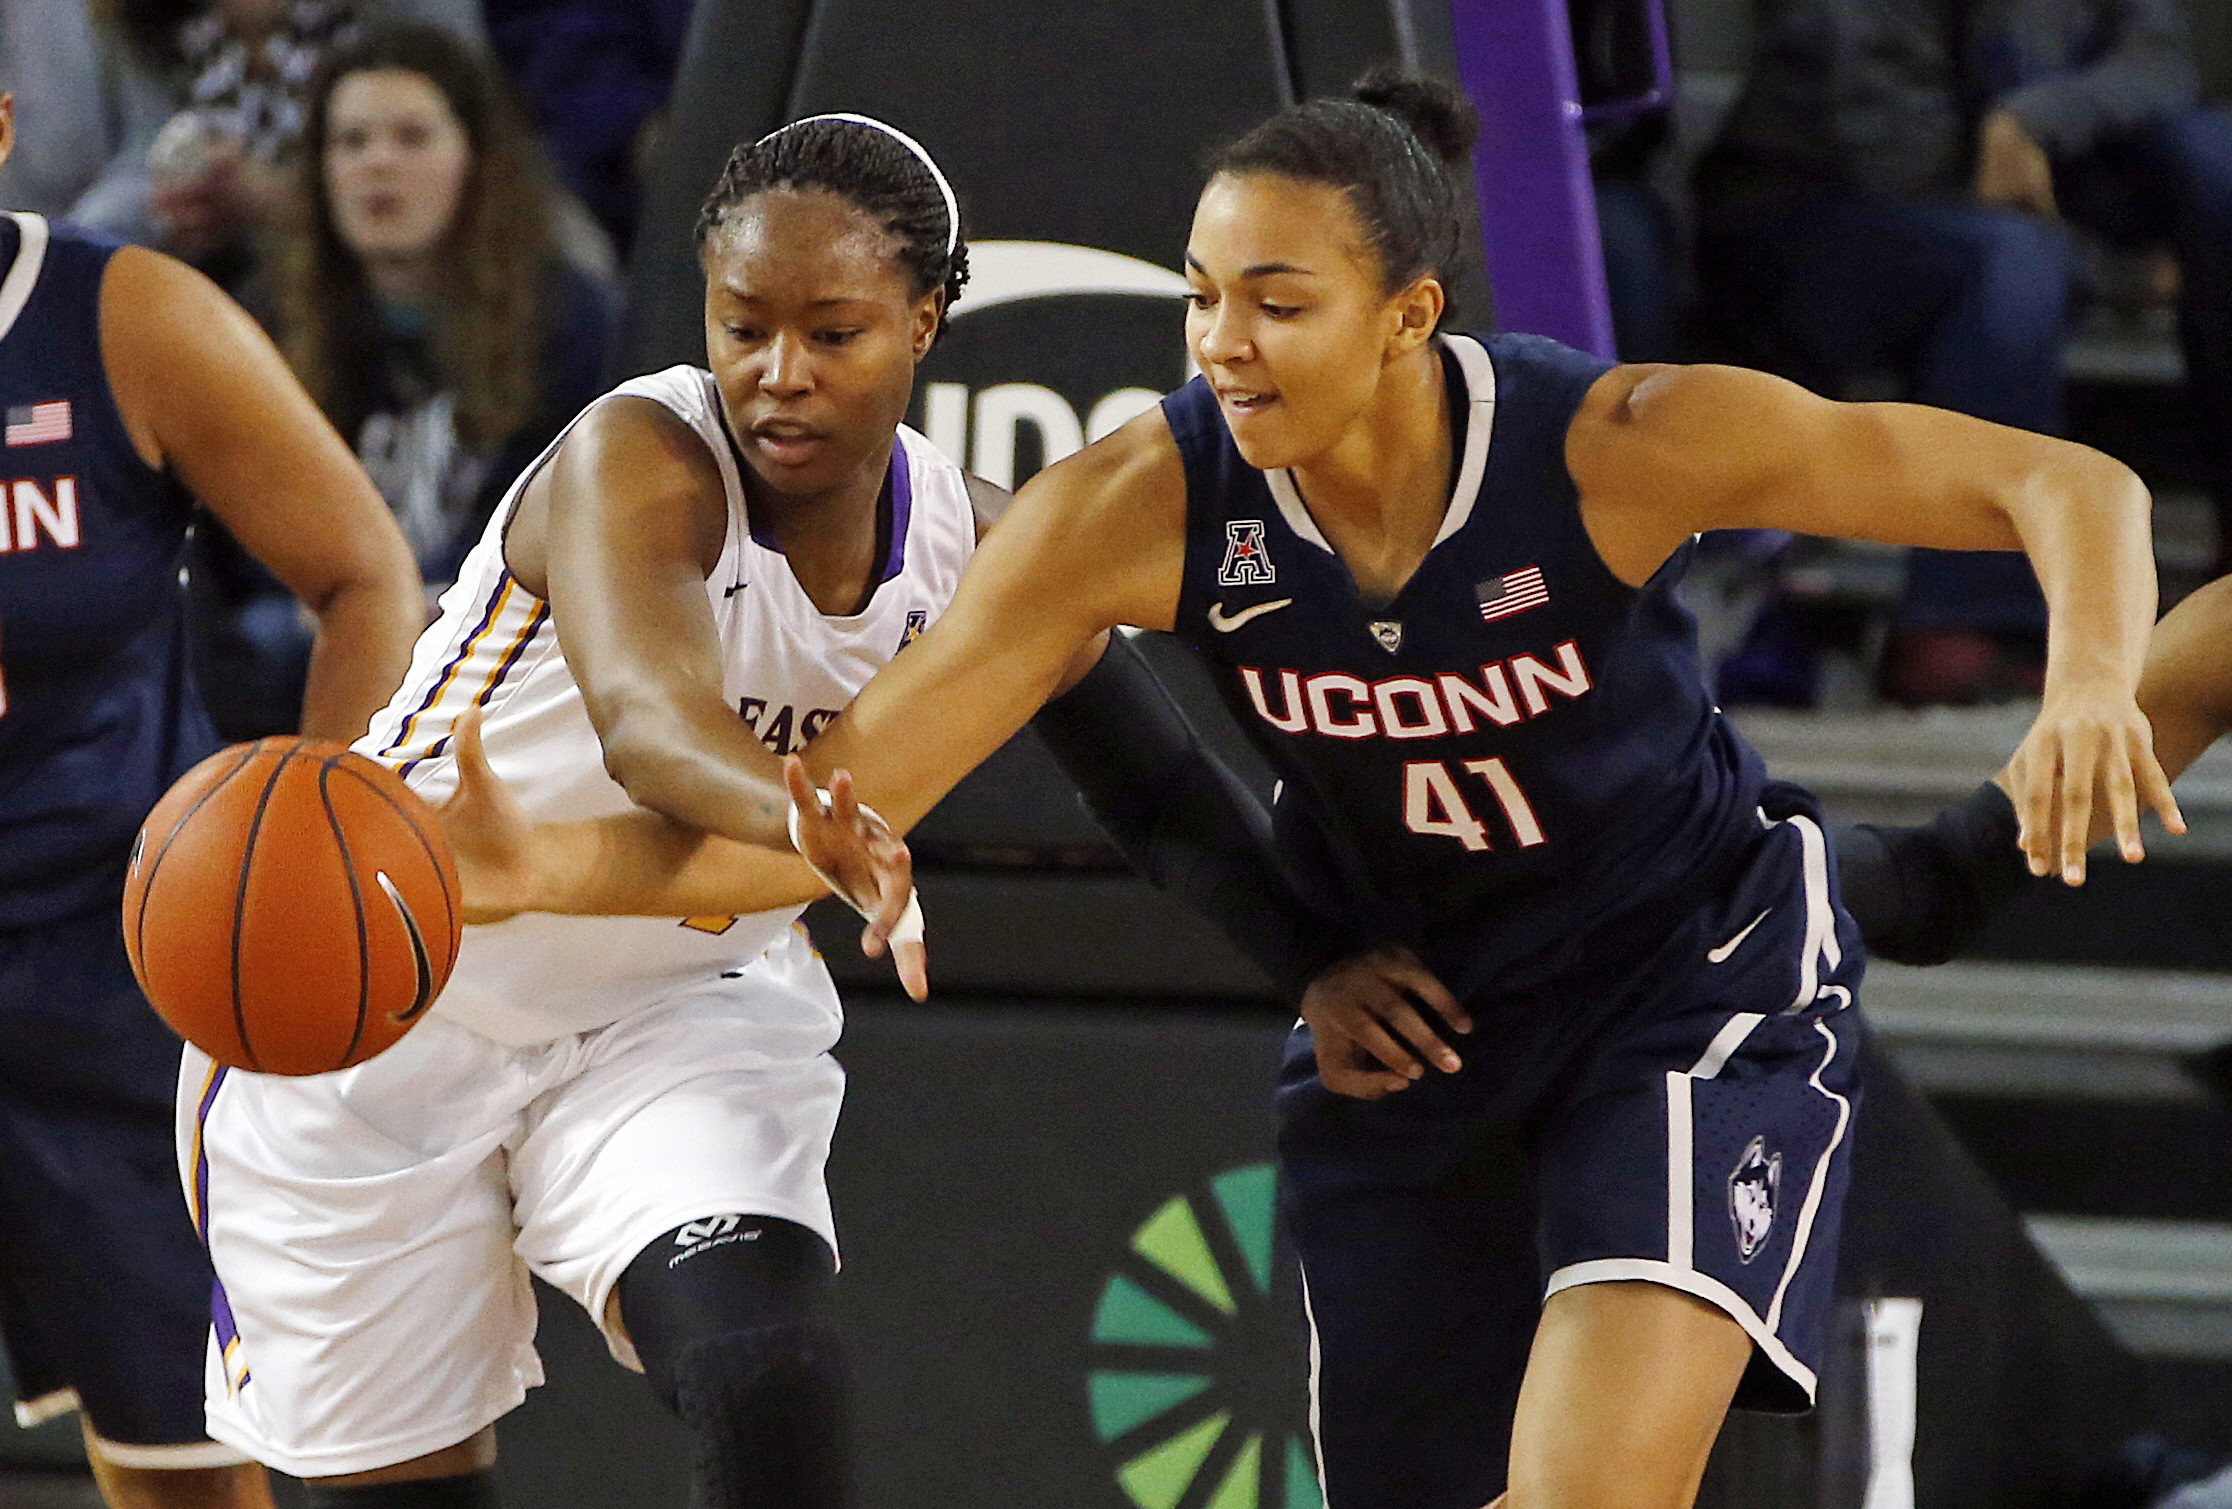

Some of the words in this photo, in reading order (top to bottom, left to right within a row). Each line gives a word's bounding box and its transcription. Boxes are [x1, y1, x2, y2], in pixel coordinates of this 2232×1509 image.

[0, 476, 81, 553] N
[1238, 637, 1593, 741] UCONN
[1402, 755, 1549, 852] 41
